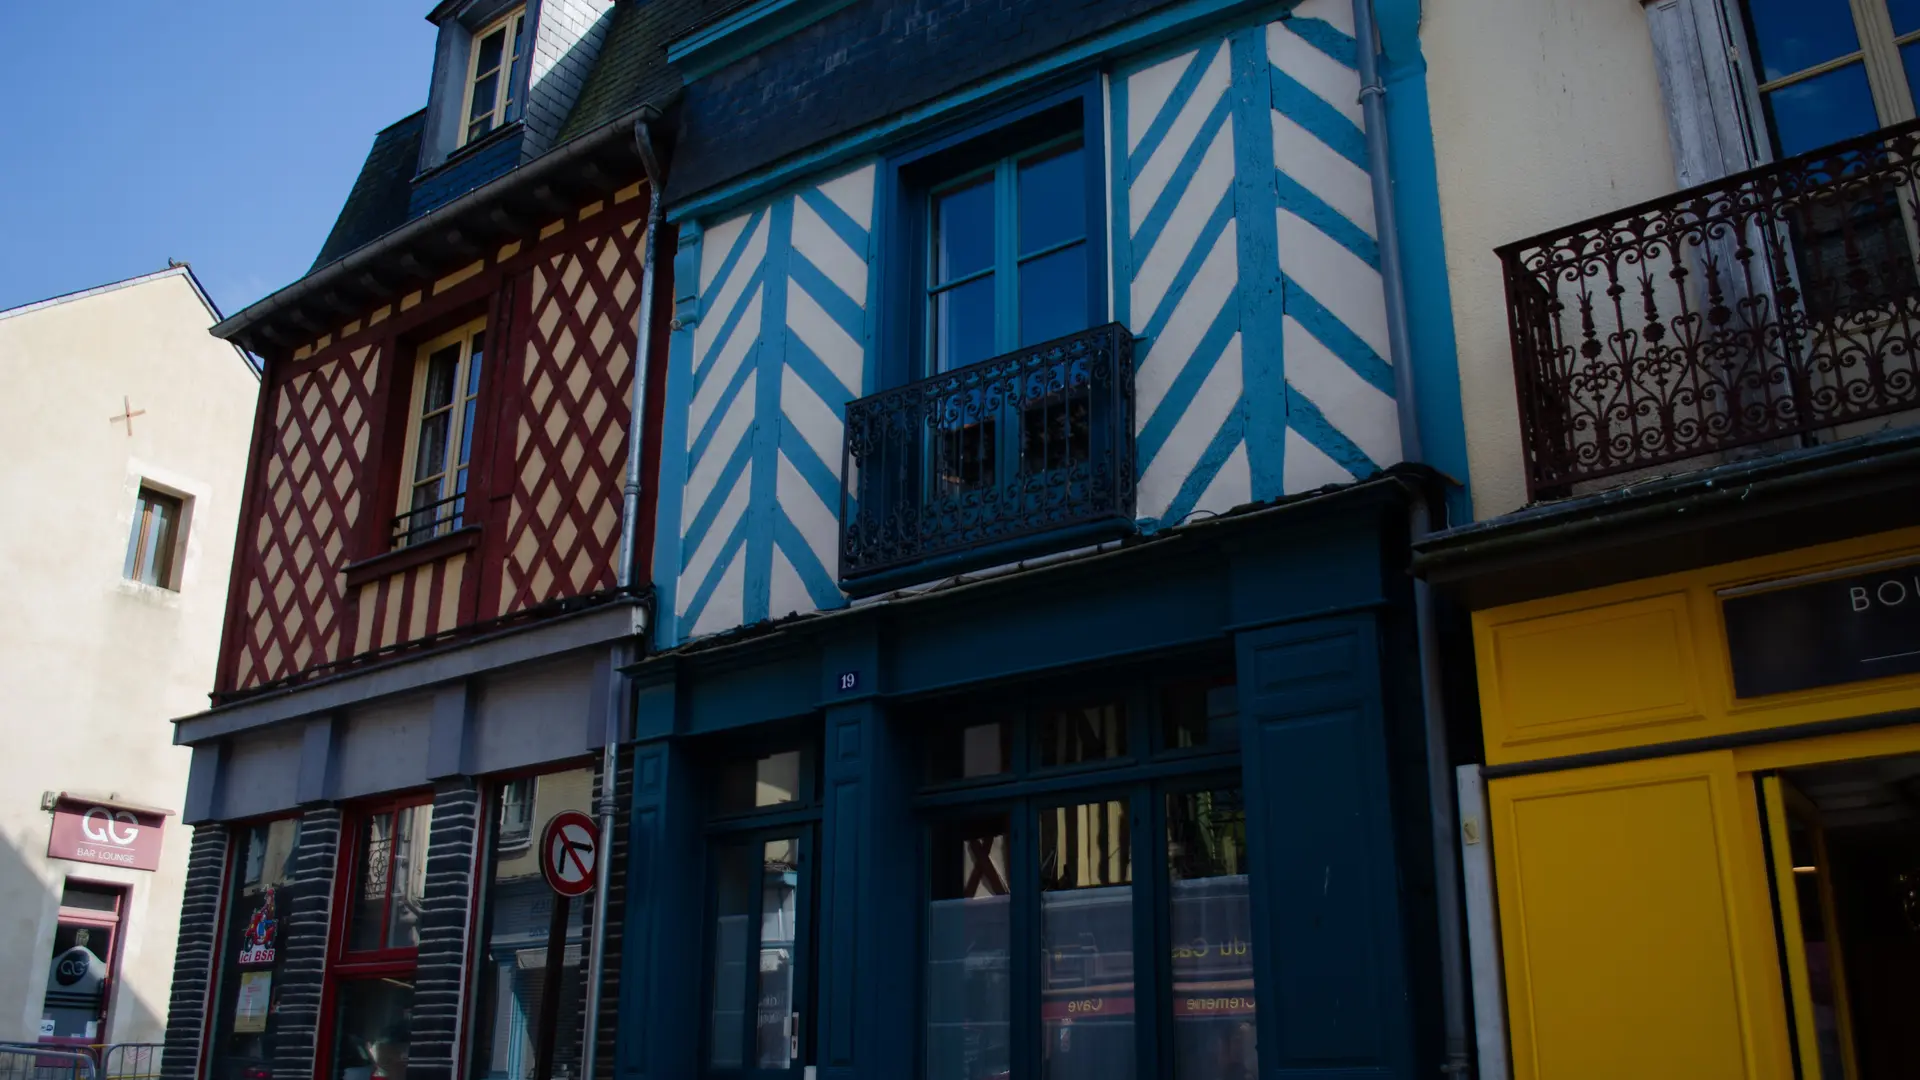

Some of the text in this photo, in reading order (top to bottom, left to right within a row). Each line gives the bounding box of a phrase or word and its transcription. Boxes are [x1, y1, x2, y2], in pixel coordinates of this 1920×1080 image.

[1849, 576, 1920, 611] BO
[841, 673, 855, 689] 19
[83, 807, 138, 845] QG
[77, 847, 134, 864] BAR LOUNGE
[254, 949, 275, 961] BSR
[60, 960, 89, 976] QG
